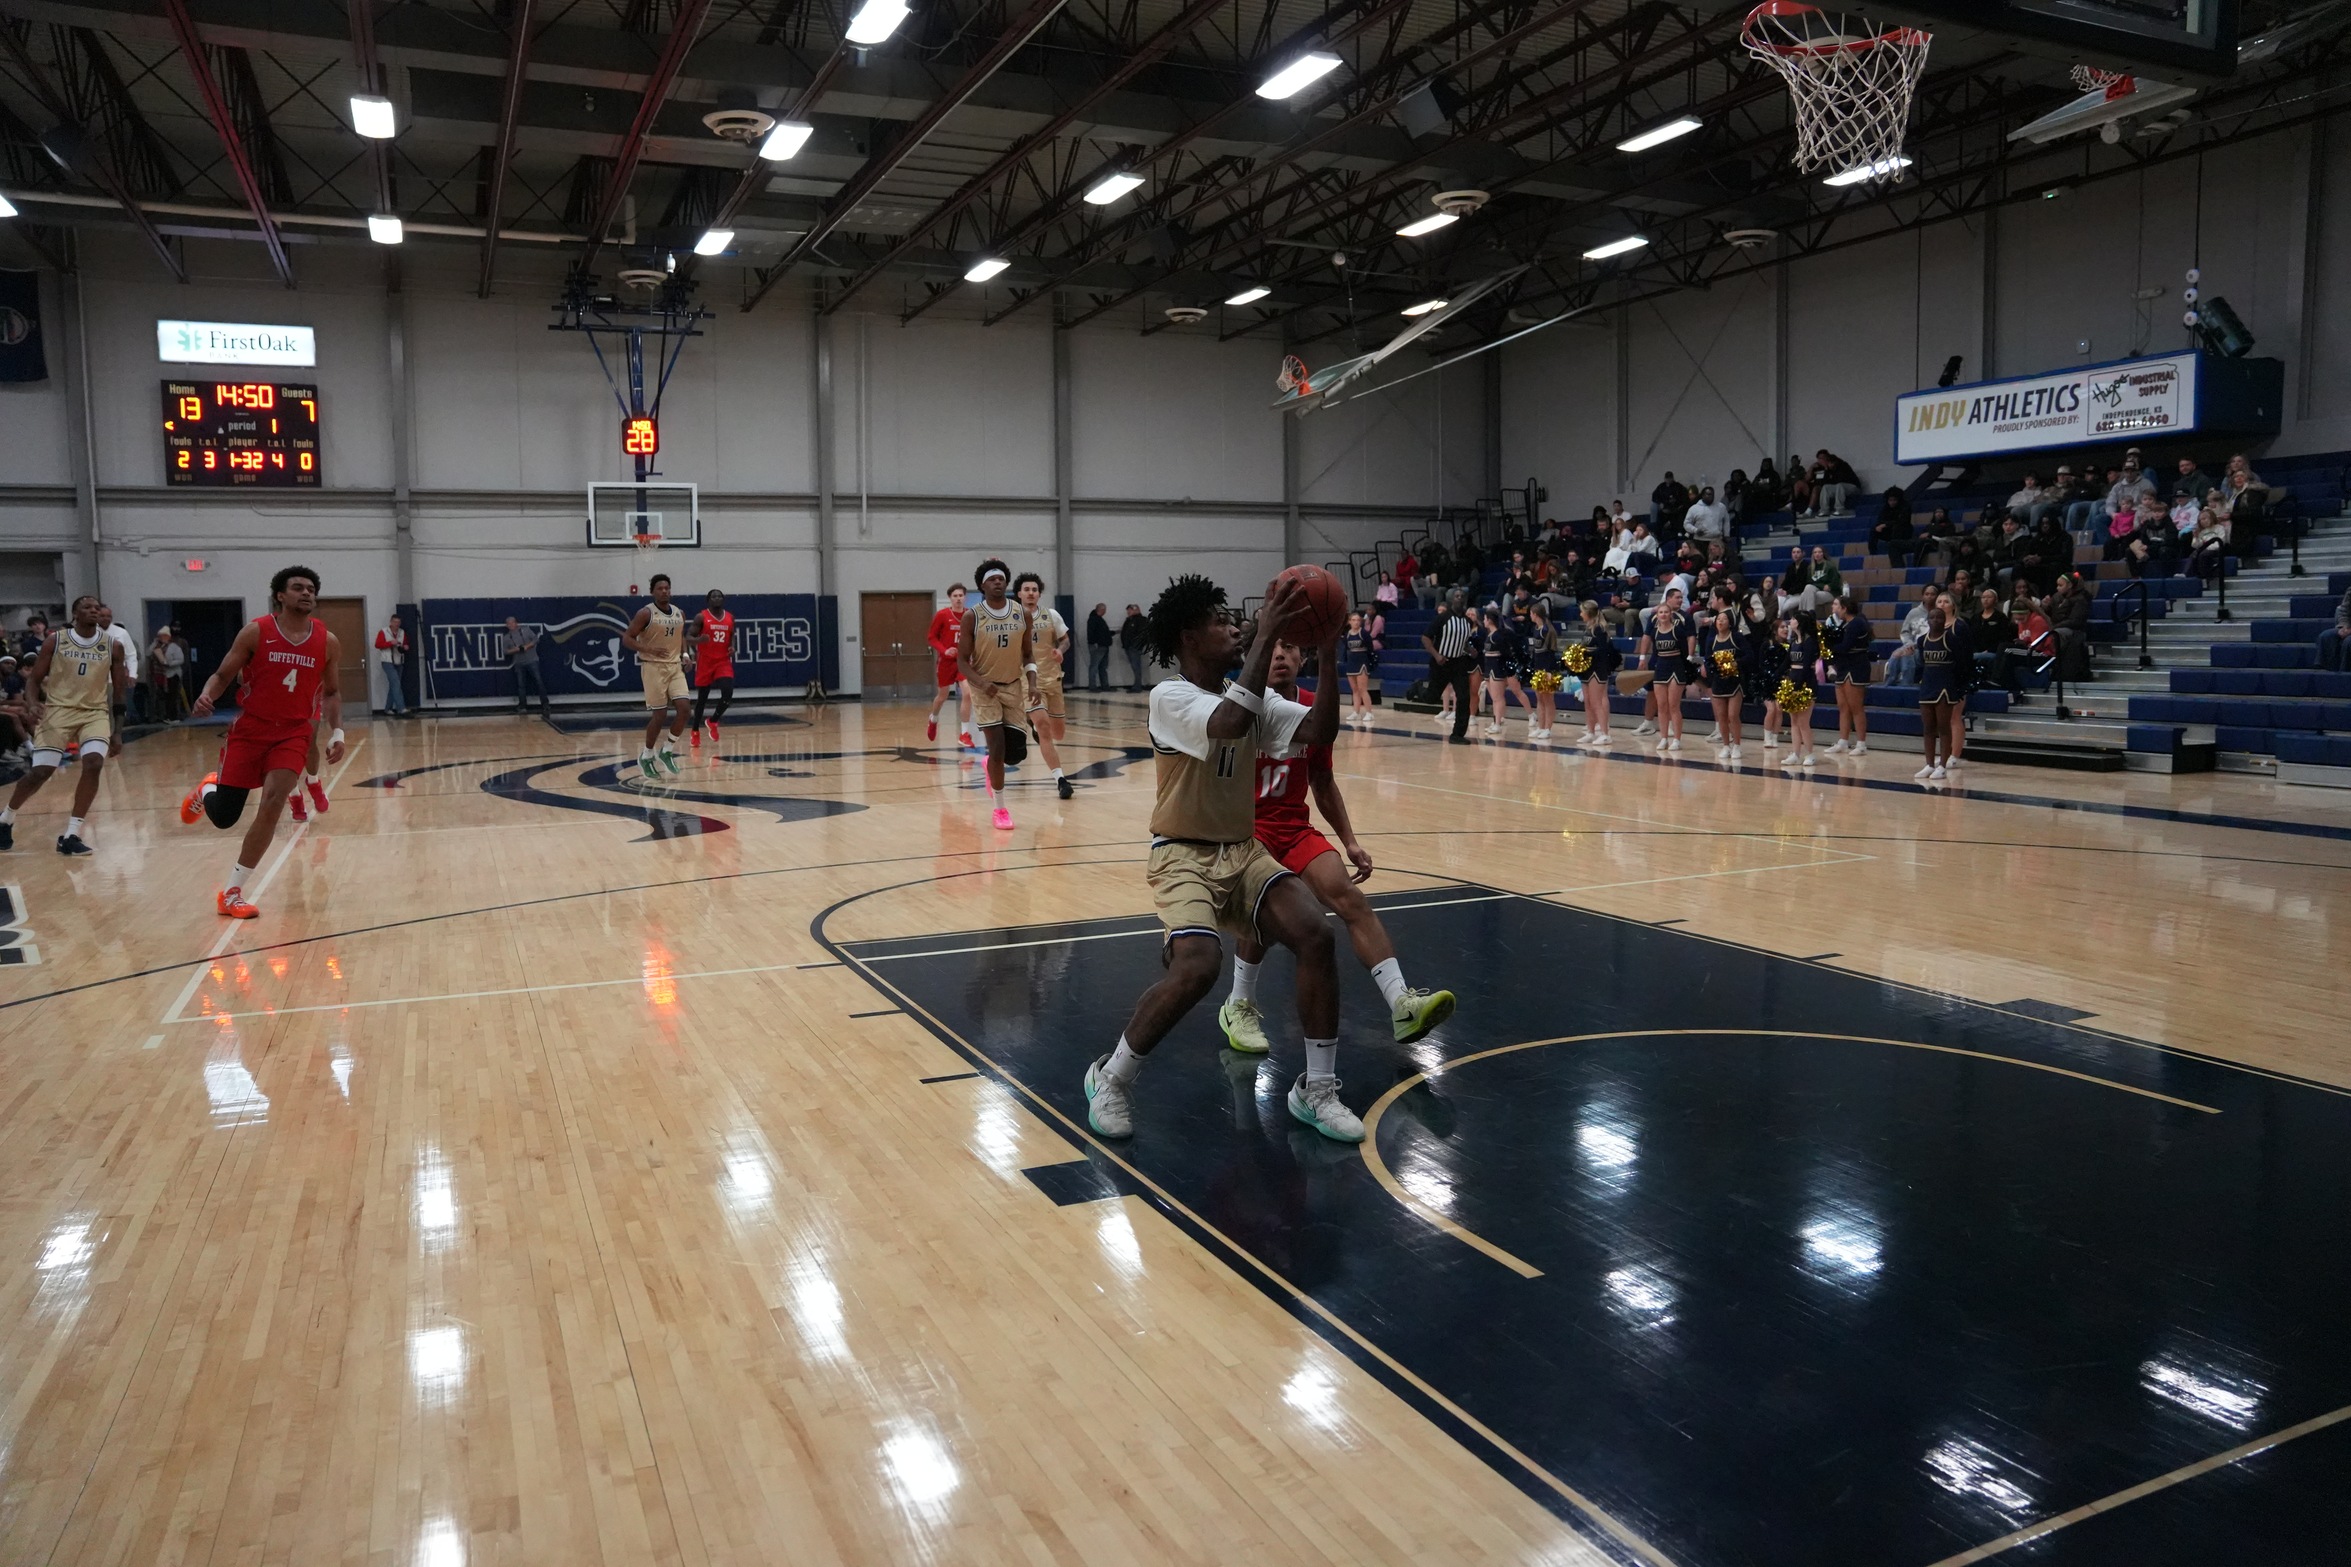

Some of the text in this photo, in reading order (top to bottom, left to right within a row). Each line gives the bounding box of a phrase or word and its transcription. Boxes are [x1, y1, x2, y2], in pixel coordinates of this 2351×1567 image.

[210, 330, 298, 352] FirstOak
[2129, 370, 2176, 386] INDUSTRIAL
[169, 384, 196, 395] Home
[216, 384, 273, 408] 14:50
[281, 387, 313, 398] Guests
[2138, 383, 2169, 397] SUPPLY
[179, 397, 201, 421] 13
[300, 400, 315, 423] 7
[1908, 382, 2081, 433] INDY ATHLETICS
[228, 421, 256, 431] period
[271, 418, 278, 434] 1
[1992, 415, 2080, 434] PROUDLY SPONSORED BY:
[170, 436, 192, 446] fouls
[228, 437, 258, 447] player
[293, 439, 314, 448] fouls
[627, 429, 655, 453] 28
[178, 450, 190, 468] 2
[204, 451, 216, 469] 3
[271, 453, 284, 469] 4
[300, 452, 313, 470] 0
[234, 474, 256, 483] game
[297, 475, 314, 483] won
[664, 627, 675, 637] 34
[986, 623, 1019, 632] PIRATES
[713, 631, 727, 643] 32
[997, 634, 1009, 648] 15
[431, 622, 544, 672] IND
[64, 650, 103, 661] PIRATES
[268, 651, 316, 669] COFFEYVILLE
[77, 662, 87, 676] 0
[282, 668, 298, 693] 4
[1216, 745, 1236, 779] 11
[1259, 764, 1291, 799] 10
